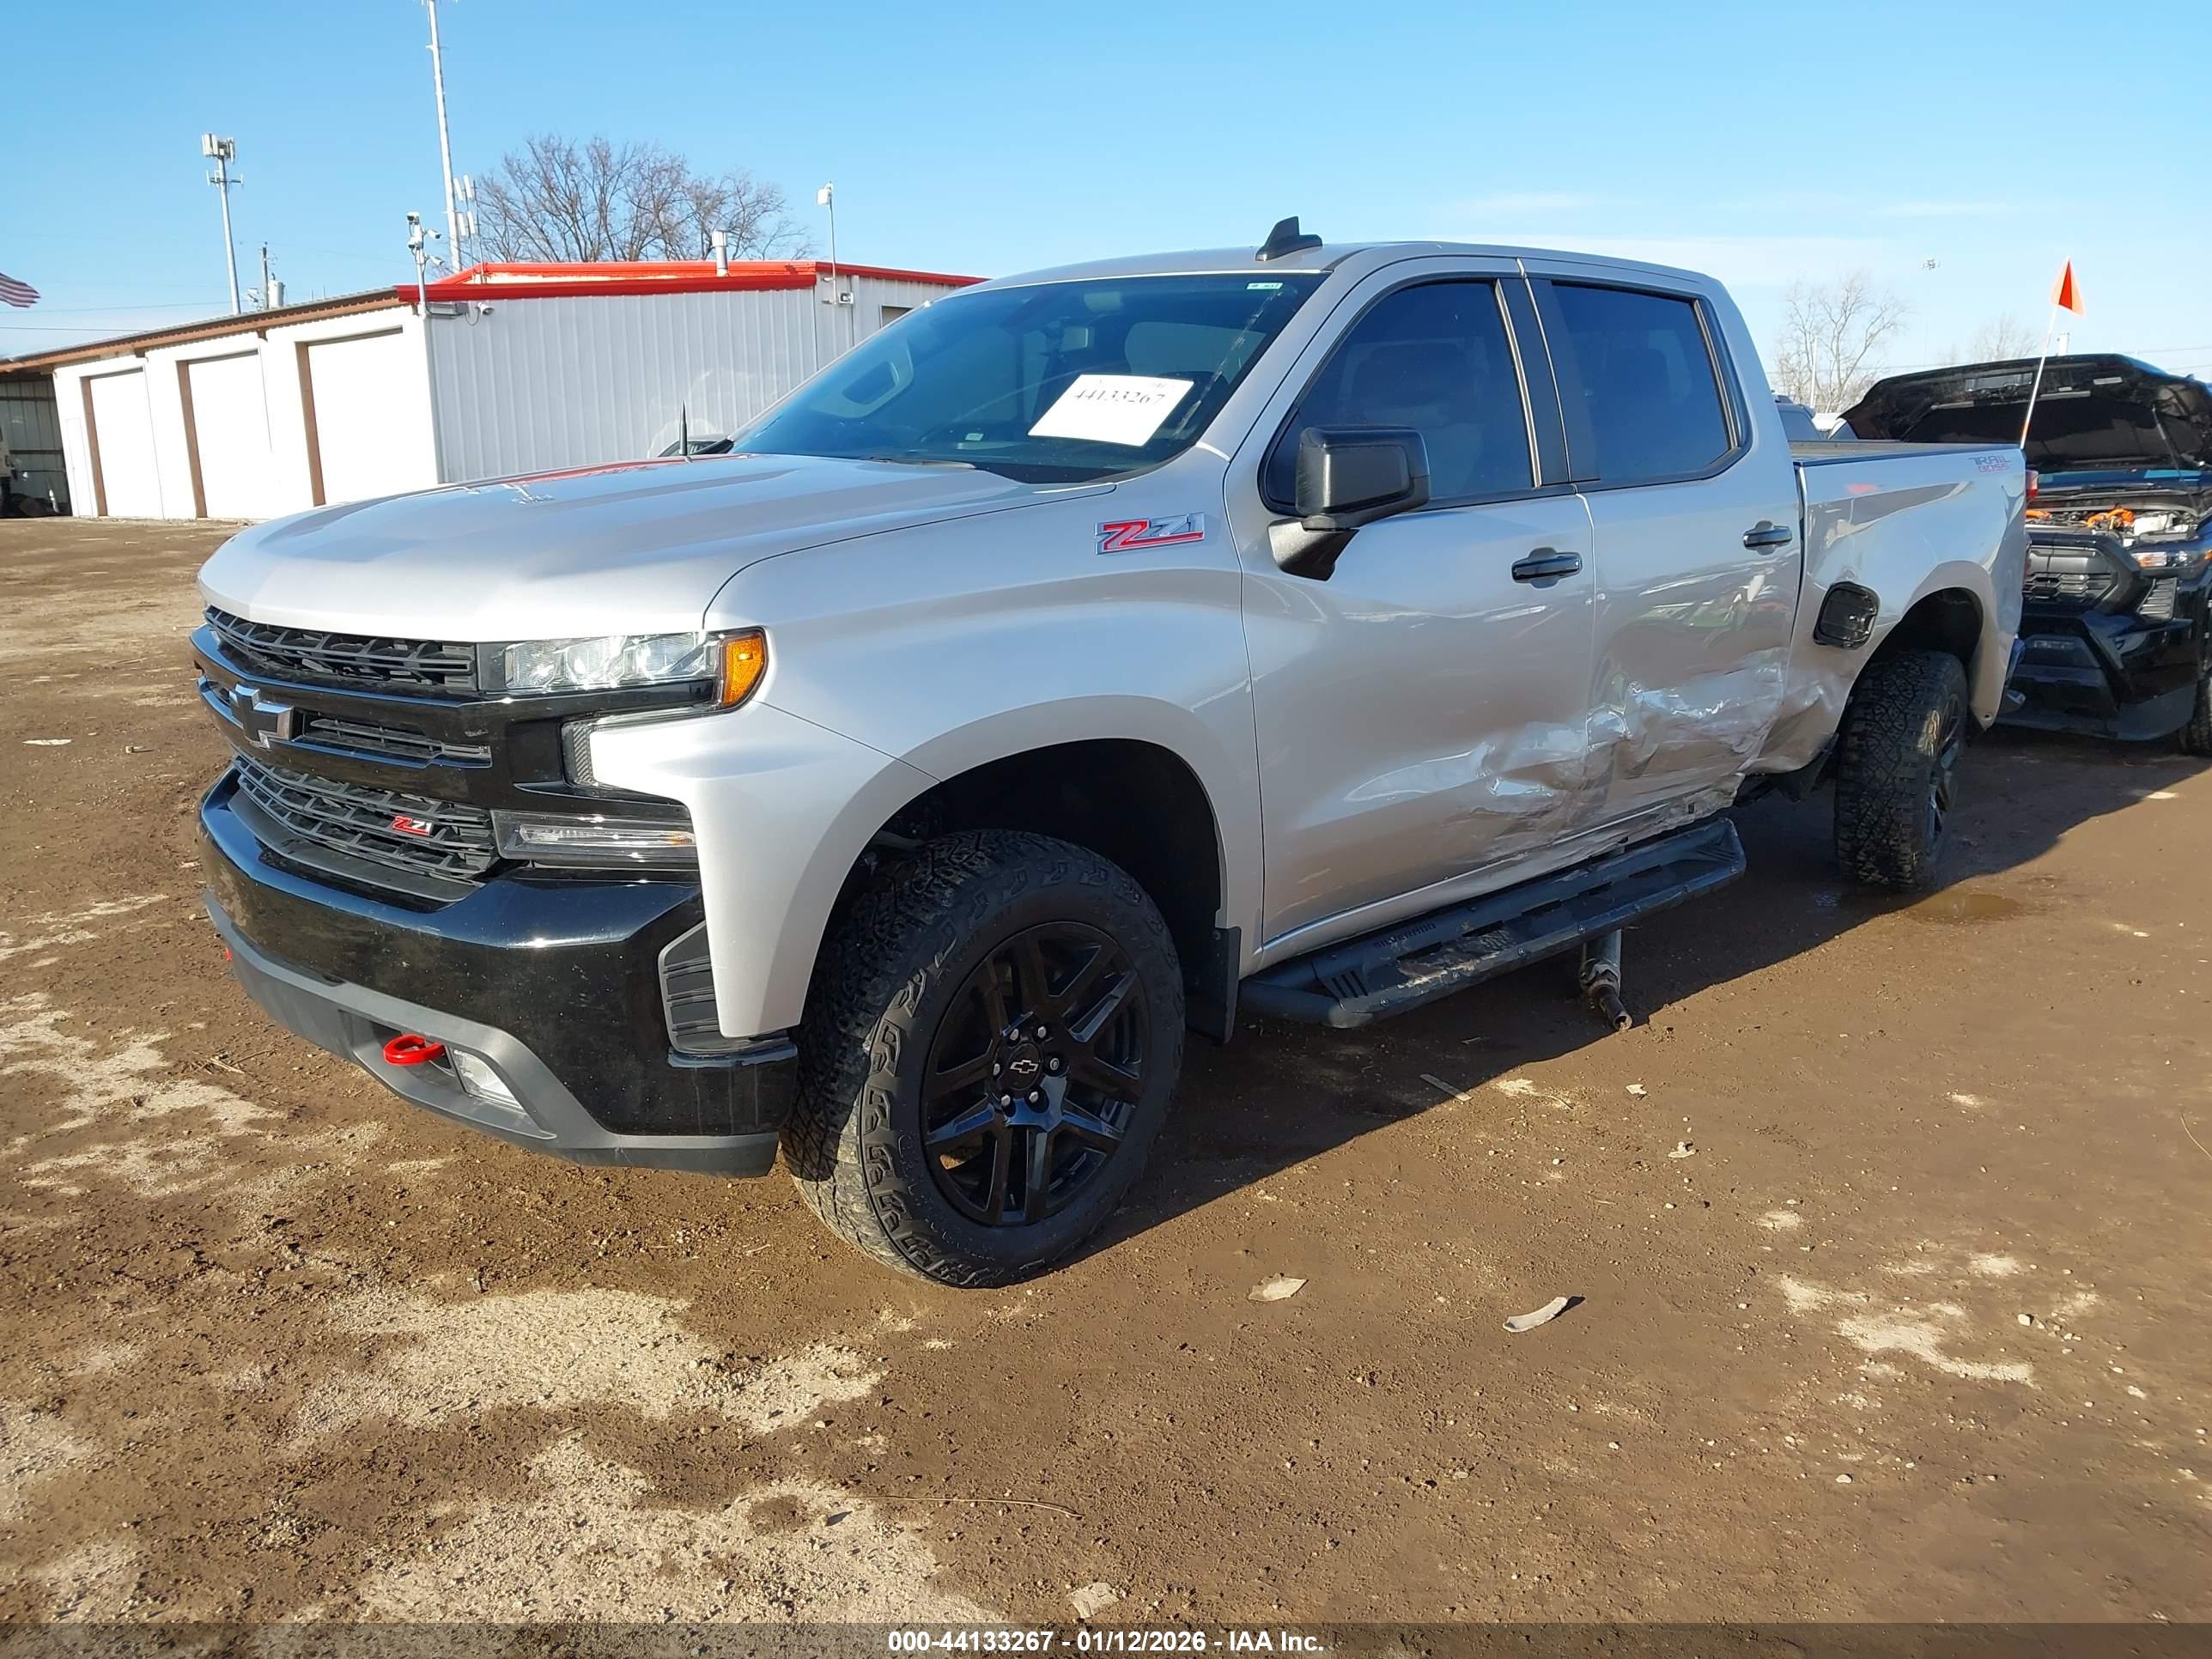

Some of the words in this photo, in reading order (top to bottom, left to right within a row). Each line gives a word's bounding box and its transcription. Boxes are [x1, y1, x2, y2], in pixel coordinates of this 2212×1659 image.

[1073, 389, 1165, 404] 44133267
[1968, 455, 2010, 465] TRAIL
[1978, 464, 2008, 473] BOSS
[1095, 512, 1204, 554] Z71
[392, 815, 432, 836] Z71
